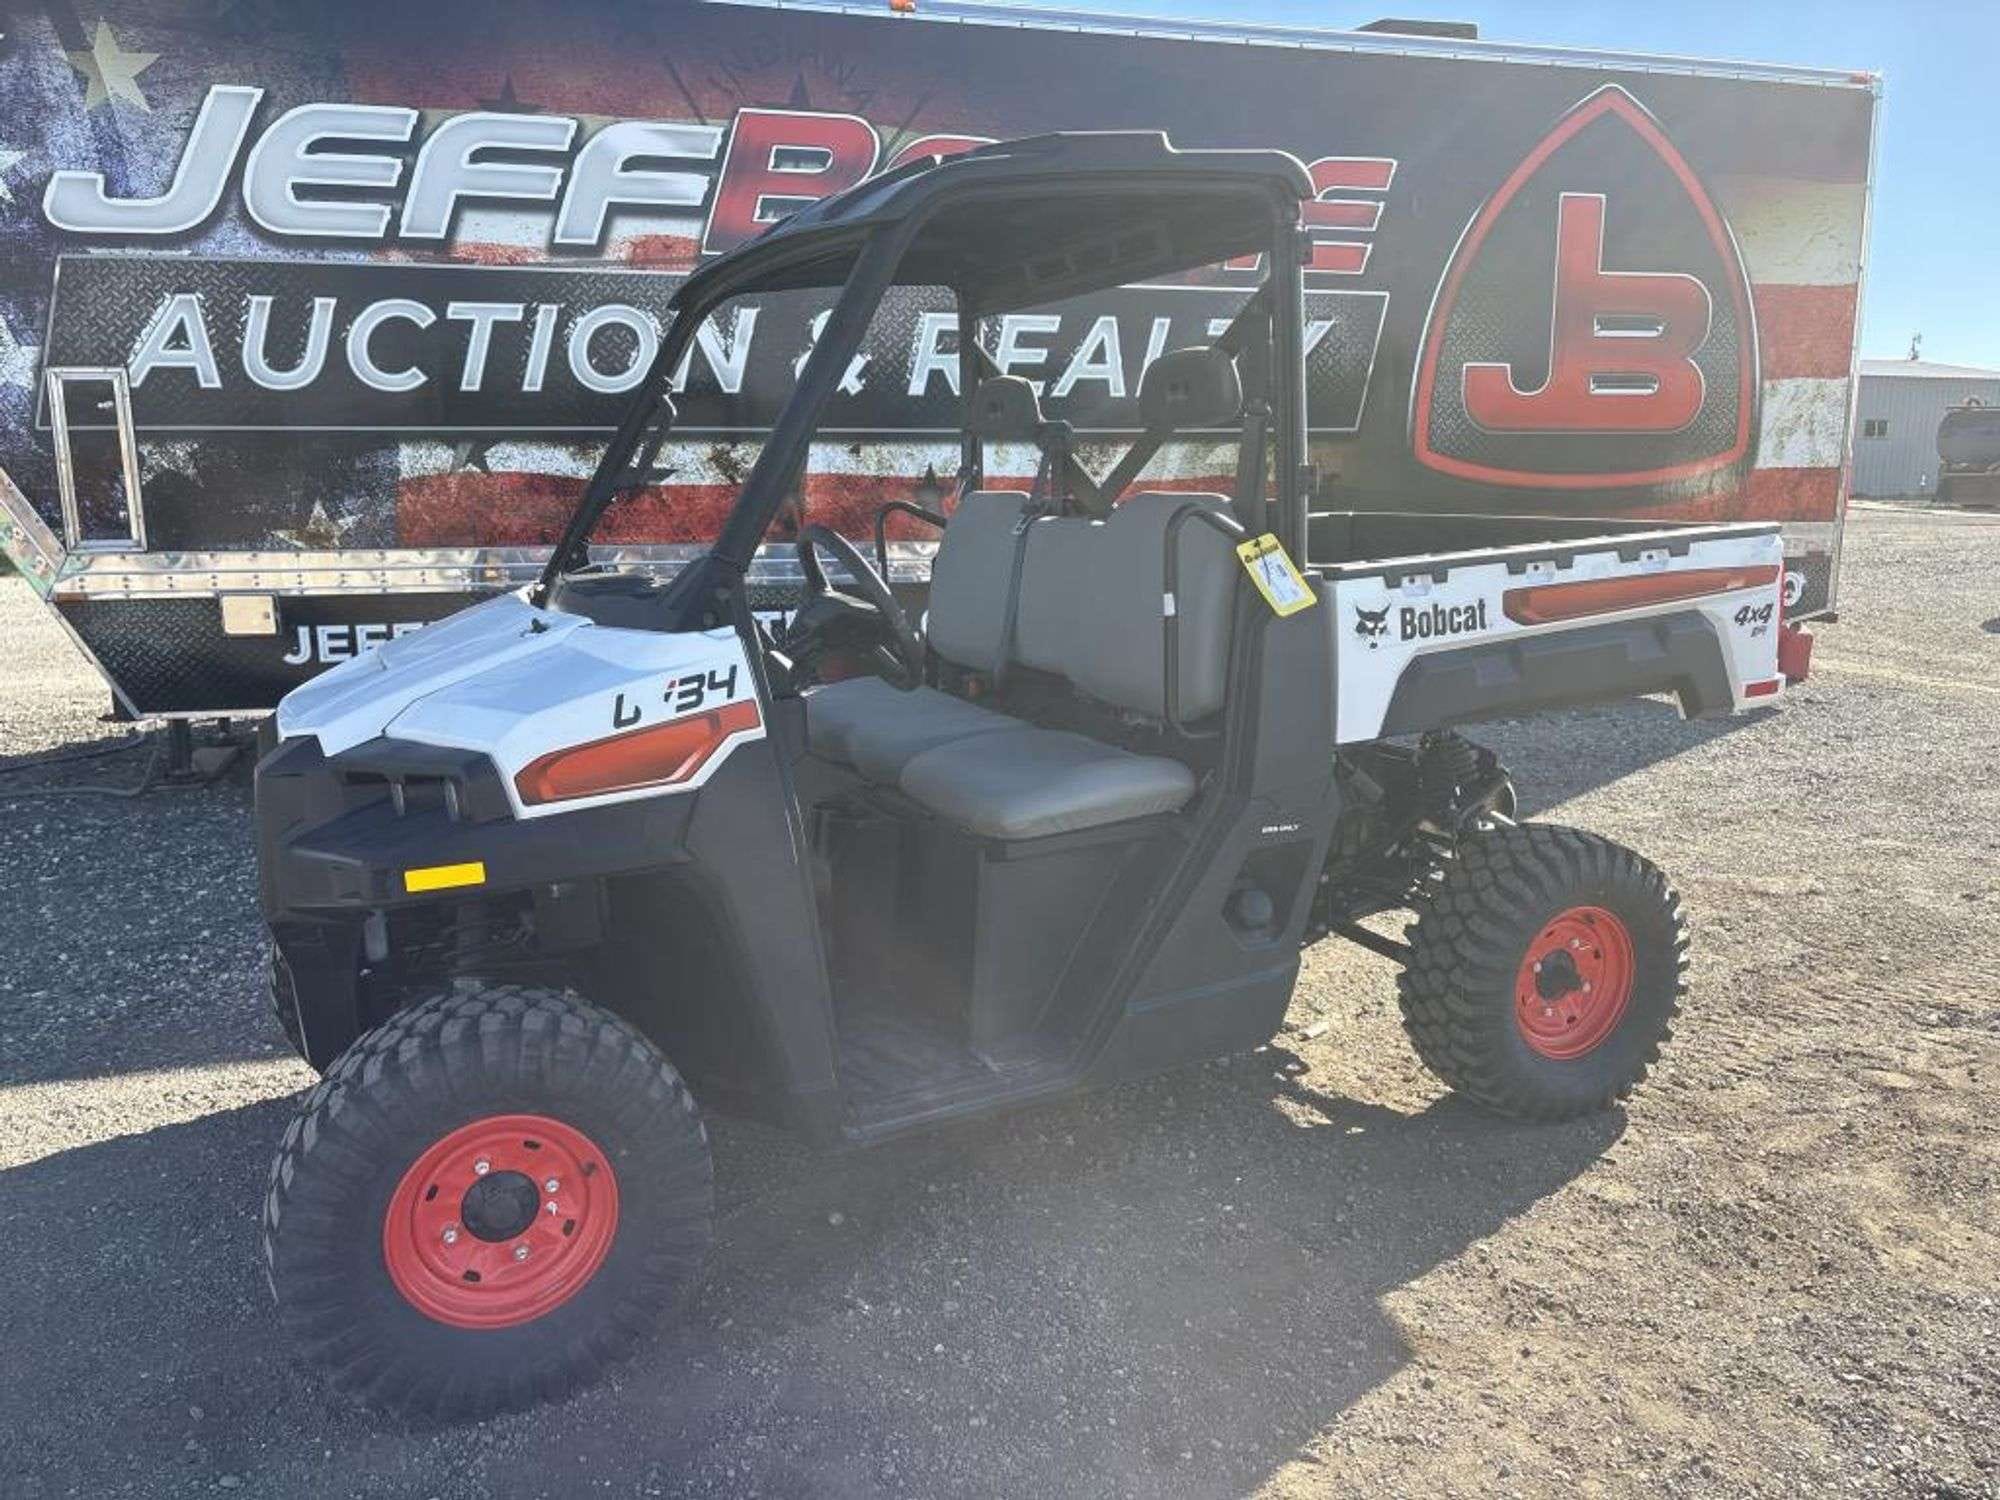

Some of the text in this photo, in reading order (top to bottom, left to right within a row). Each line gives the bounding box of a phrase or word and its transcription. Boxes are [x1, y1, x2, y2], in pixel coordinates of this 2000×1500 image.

[131, 294, 760, 394] AUCTION
[1463, 191, 1713, 435] JB
[1400, 598, 1487, 641] Bobcat
